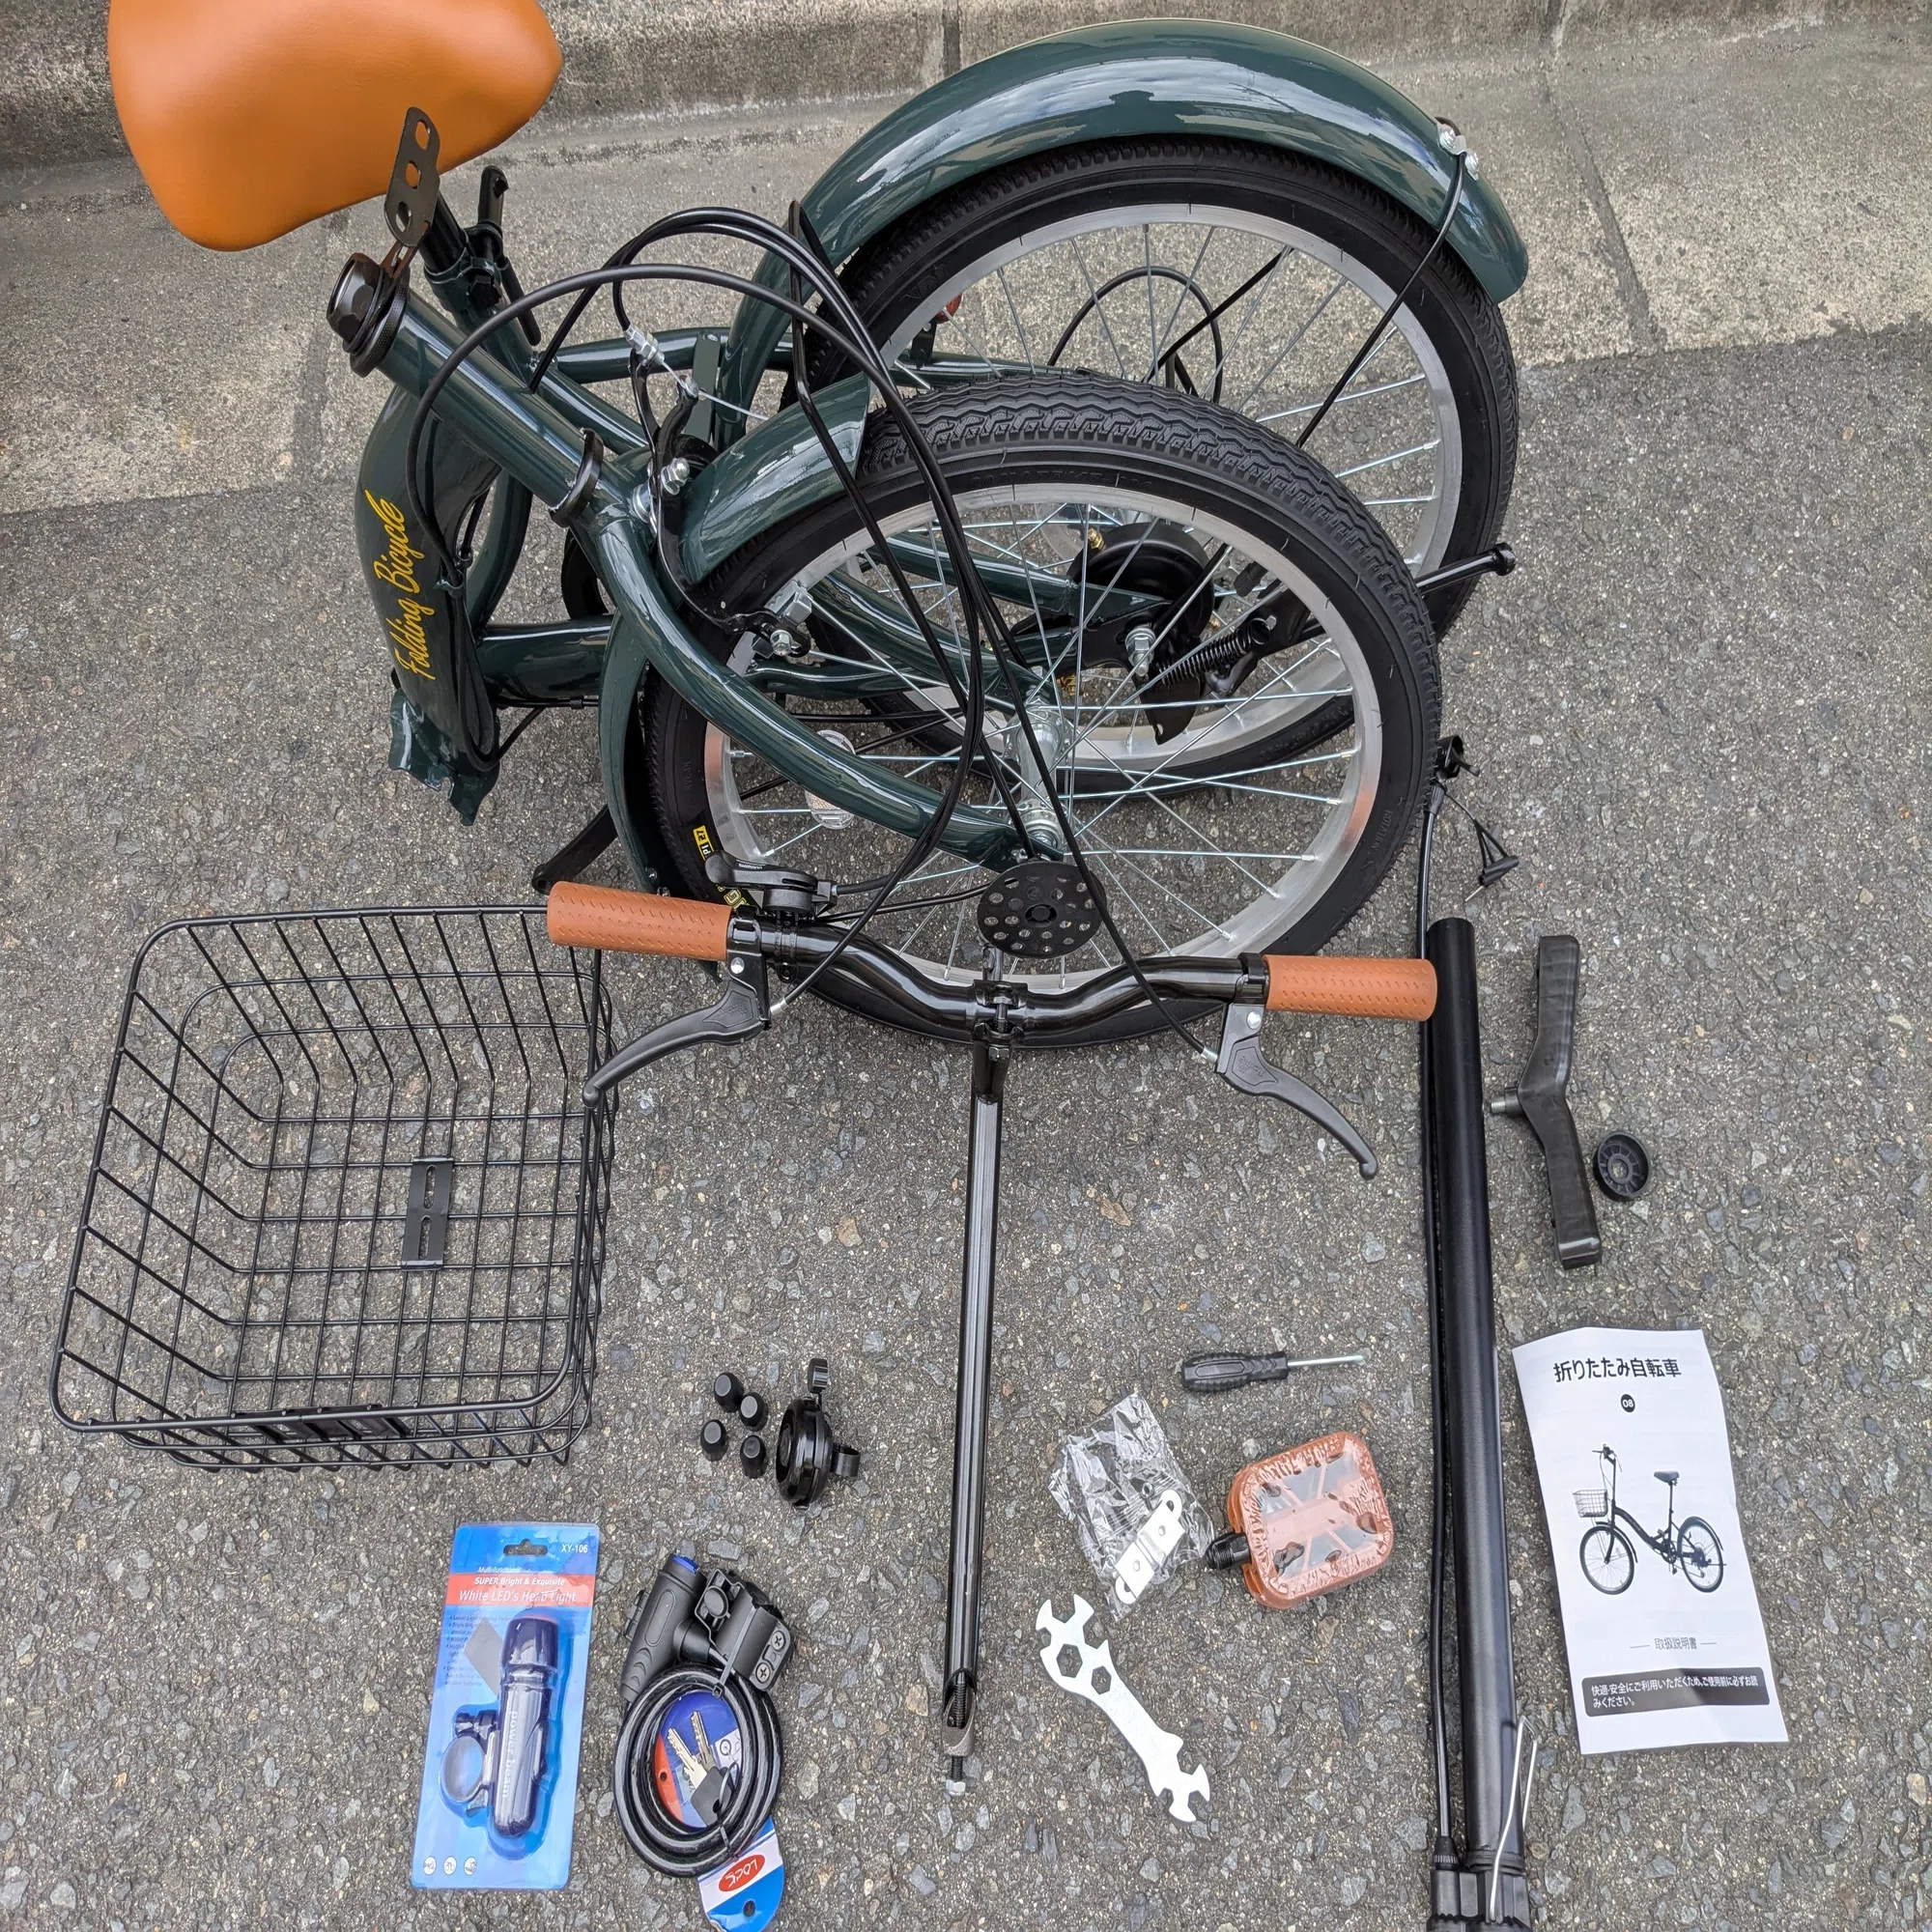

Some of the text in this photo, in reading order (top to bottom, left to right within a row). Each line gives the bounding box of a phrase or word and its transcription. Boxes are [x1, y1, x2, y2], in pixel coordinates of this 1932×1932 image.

[364, 489, 437, 681] Folding Bicycle
[1552, 1356, 1682, 1383] 折りたたみ自転車
[560, 1543, 588, 1553] XY-106
[474, 1577, 565, 1587] SUPER Bright & Exquisite
[459, 1589, 489, 1602] White
[491, 1590, 519, 1602] LED's
[1654, 1636, 1698, 1651] 取扱説明書
[501, 1711, 519, 1798] power beam
[724, 1858, 758, 1889] LOCK
